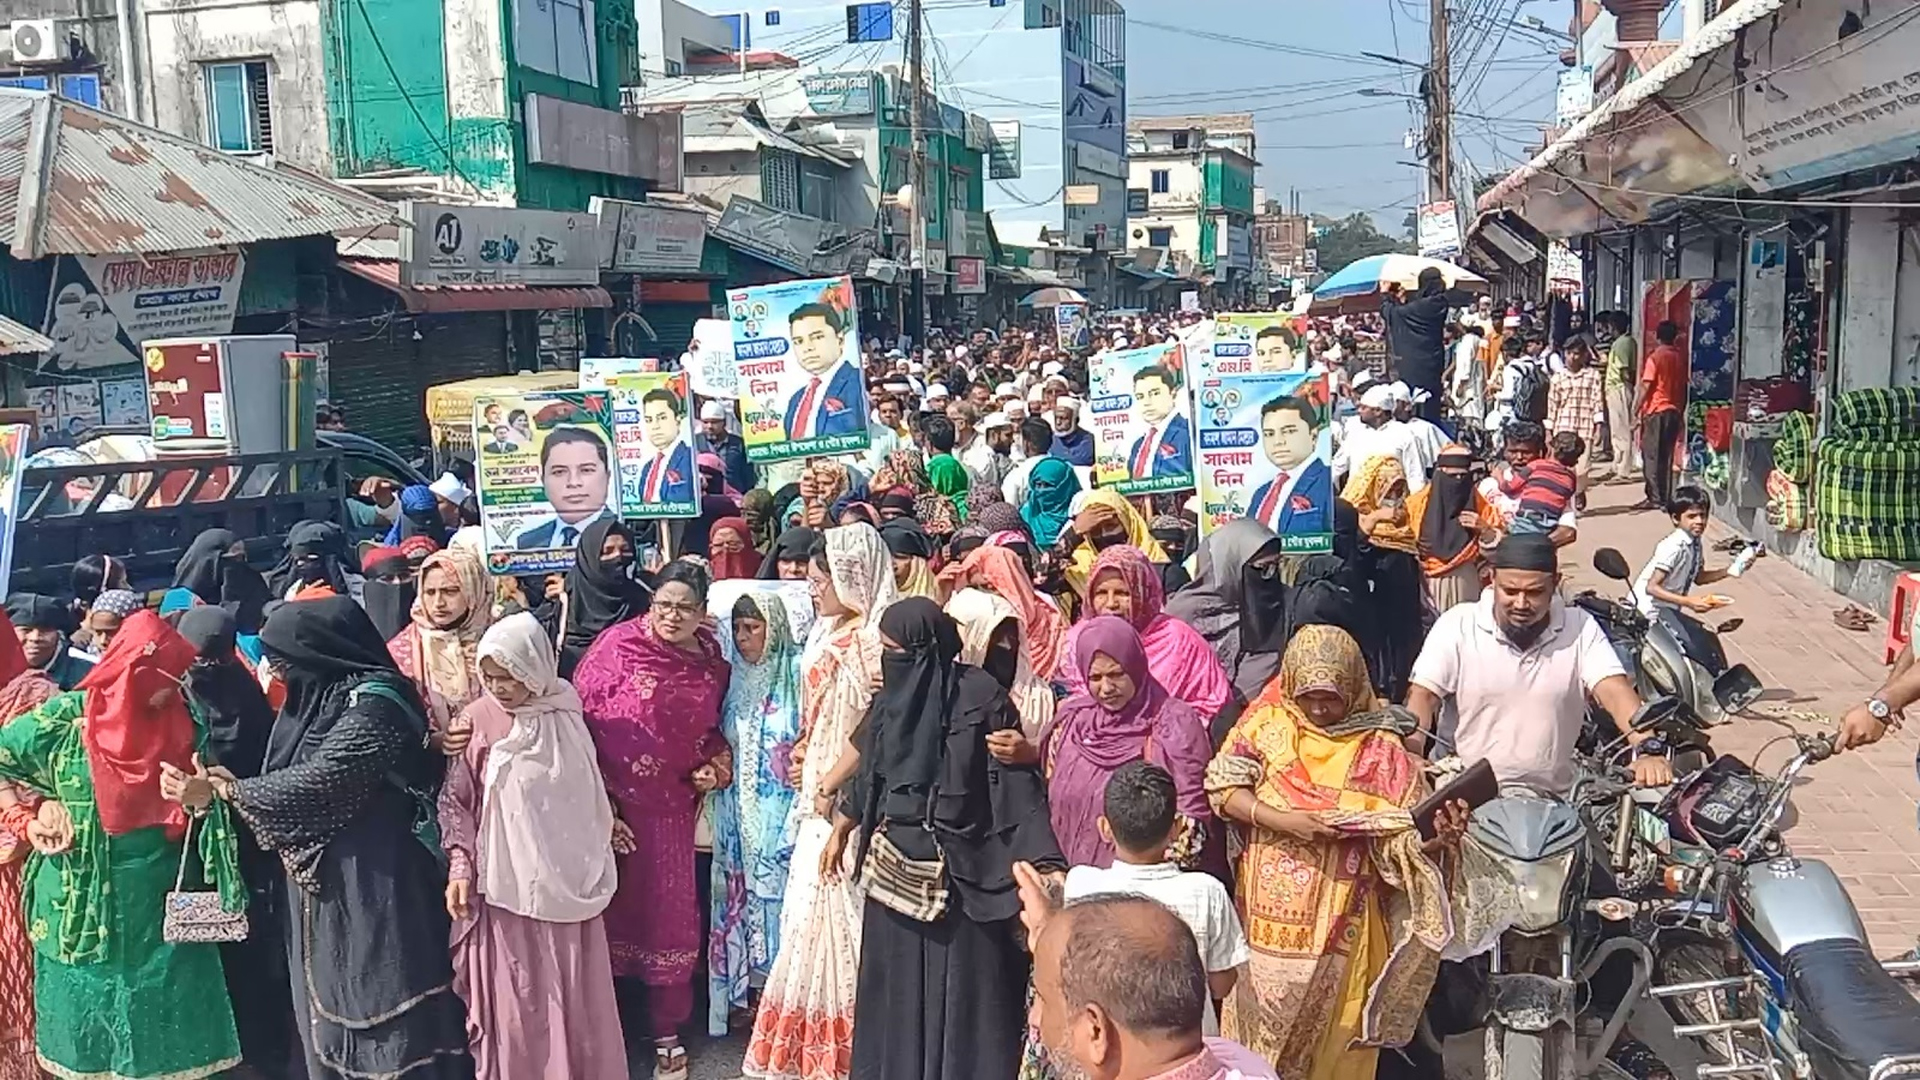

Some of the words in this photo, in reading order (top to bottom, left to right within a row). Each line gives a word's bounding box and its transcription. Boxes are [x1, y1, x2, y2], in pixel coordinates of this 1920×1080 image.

[739, 361, 785, 376] সালাম
[750, 379, 778, 397] নিন
[1094, 413, 1129, 427] সালাম
[1102, 428, 1124, 443] নিন
[1203, 452, 1252, 467] সালাম
[1213, 469, 1244, 487] নিন
